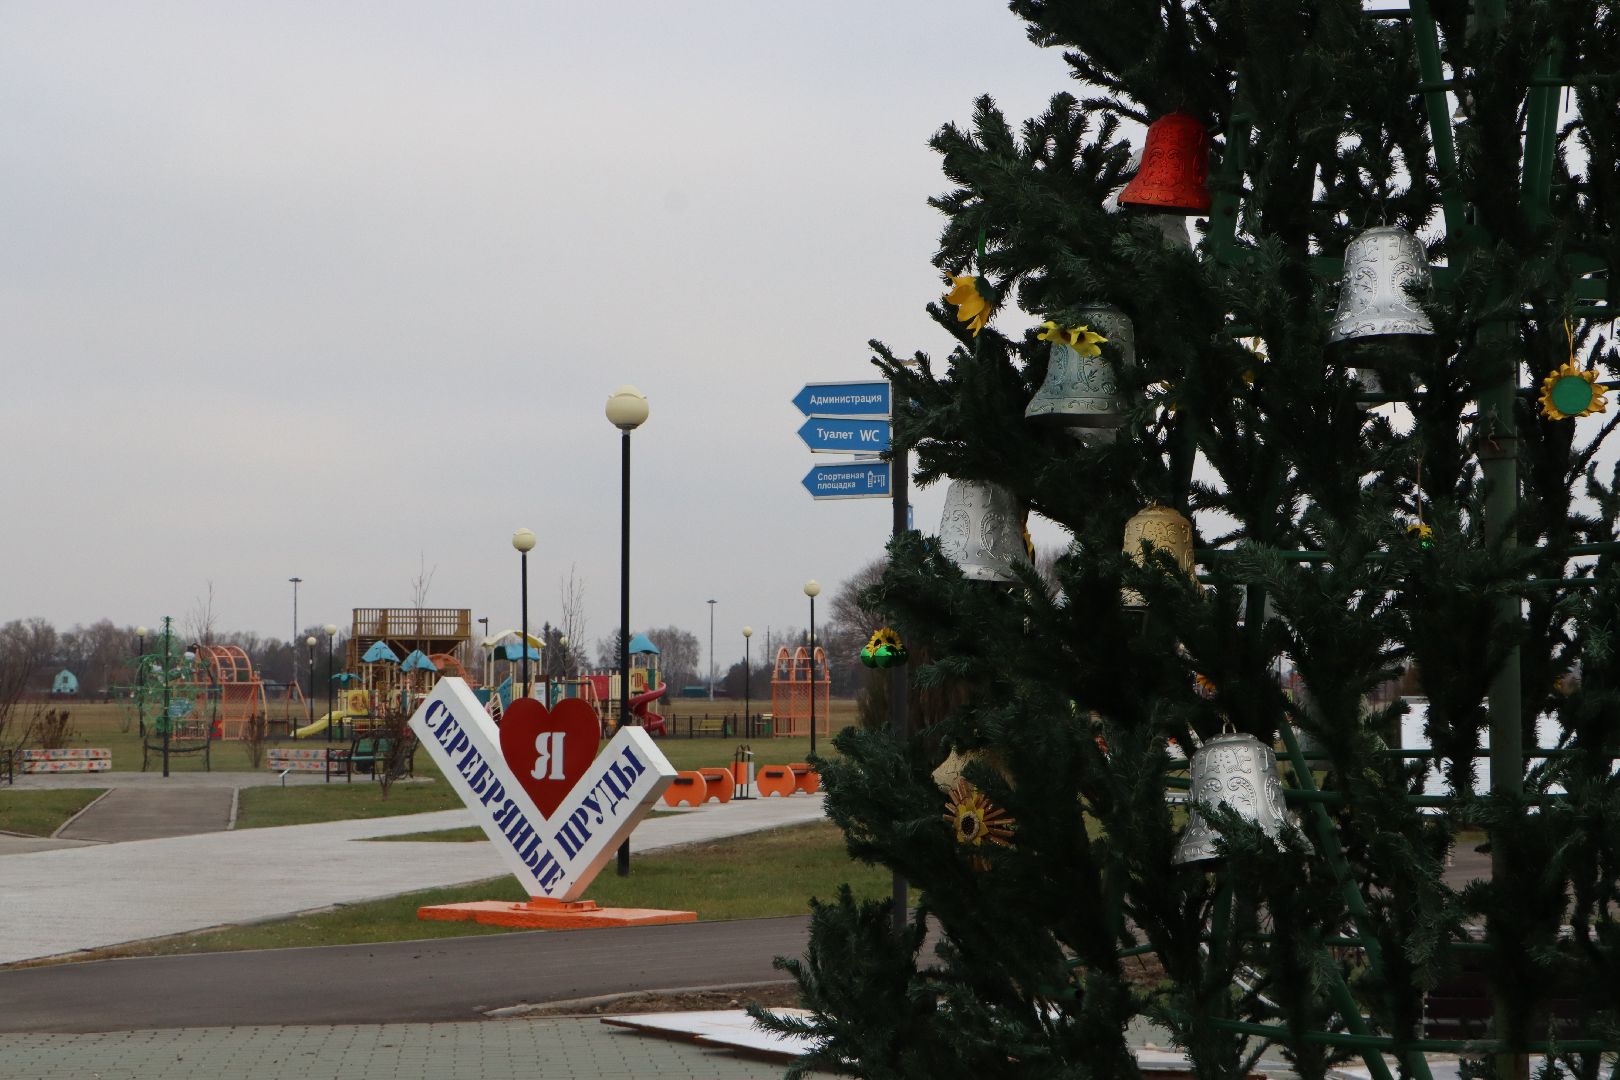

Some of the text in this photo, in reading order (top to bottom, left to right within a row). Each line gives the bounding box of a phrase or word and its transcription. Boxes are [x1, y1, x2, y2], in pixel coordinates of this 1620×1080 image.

[810, 394, 882, 405] Администрация
[817, 428, 880, 441] Туалет WC
[818, 472, 865, 482] Спортивная
[817, 481, 856, 490] площадка
[531, 731, 566, 780] Я
[424, 699, 565, 896] СЕРЕБРЯНЫЕ
[554, 745, 646, 861] ПРУДЫ
